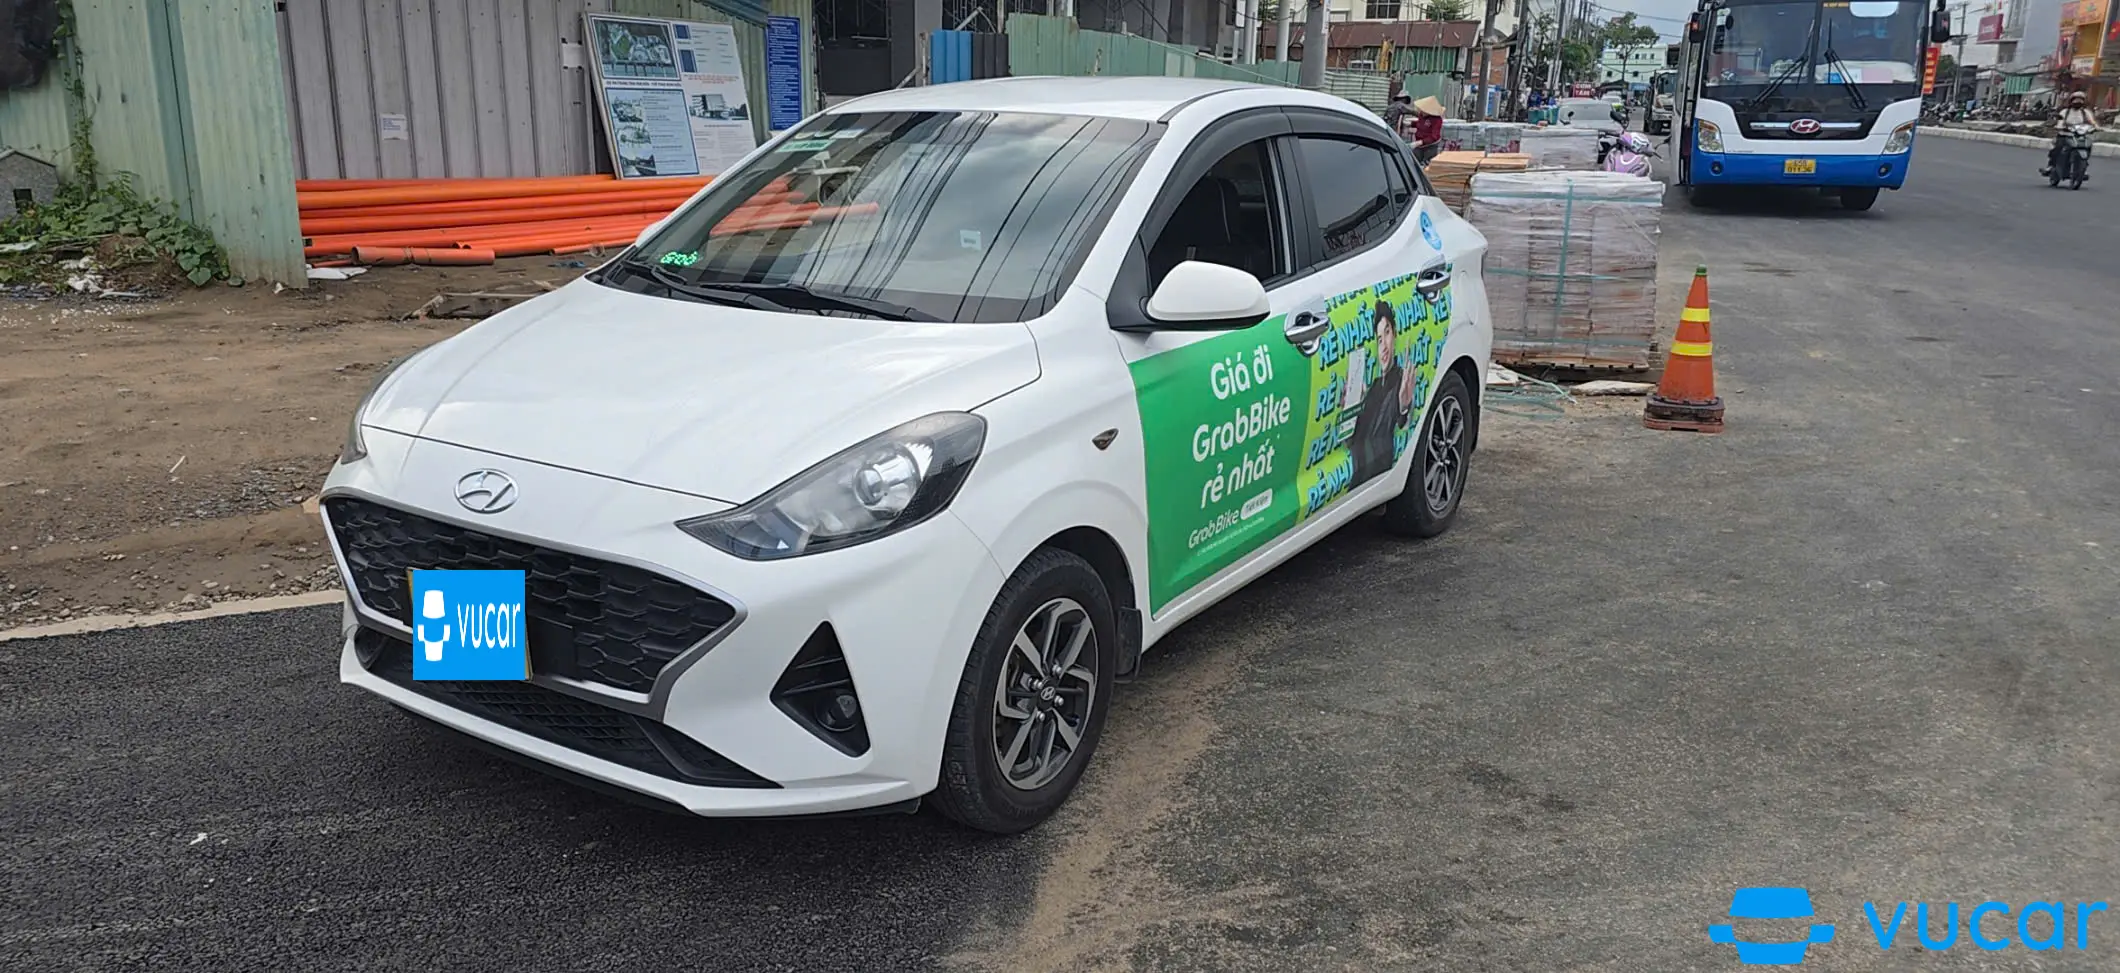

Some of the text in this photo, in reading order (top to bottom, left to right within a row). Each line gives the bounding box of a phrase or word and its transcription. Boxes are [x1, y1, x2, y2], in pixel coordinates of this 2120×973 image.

[1338, 300, 1375, 358] NHẤT
[1211, 344, 1273, 400] Giá đi
[1315, 372, 1337, 422] RẺ
[1192, 393, 1290, 462] GrabBike
[1305, 422, 1327, 470] RẺ
[1201, 462, 1224, 509] rẻ
[1227, 438, 1275, 495] nhất
[1304, 468, 1327, 518] RẺ
[1188, 509, 1239, 549] GrabBike
